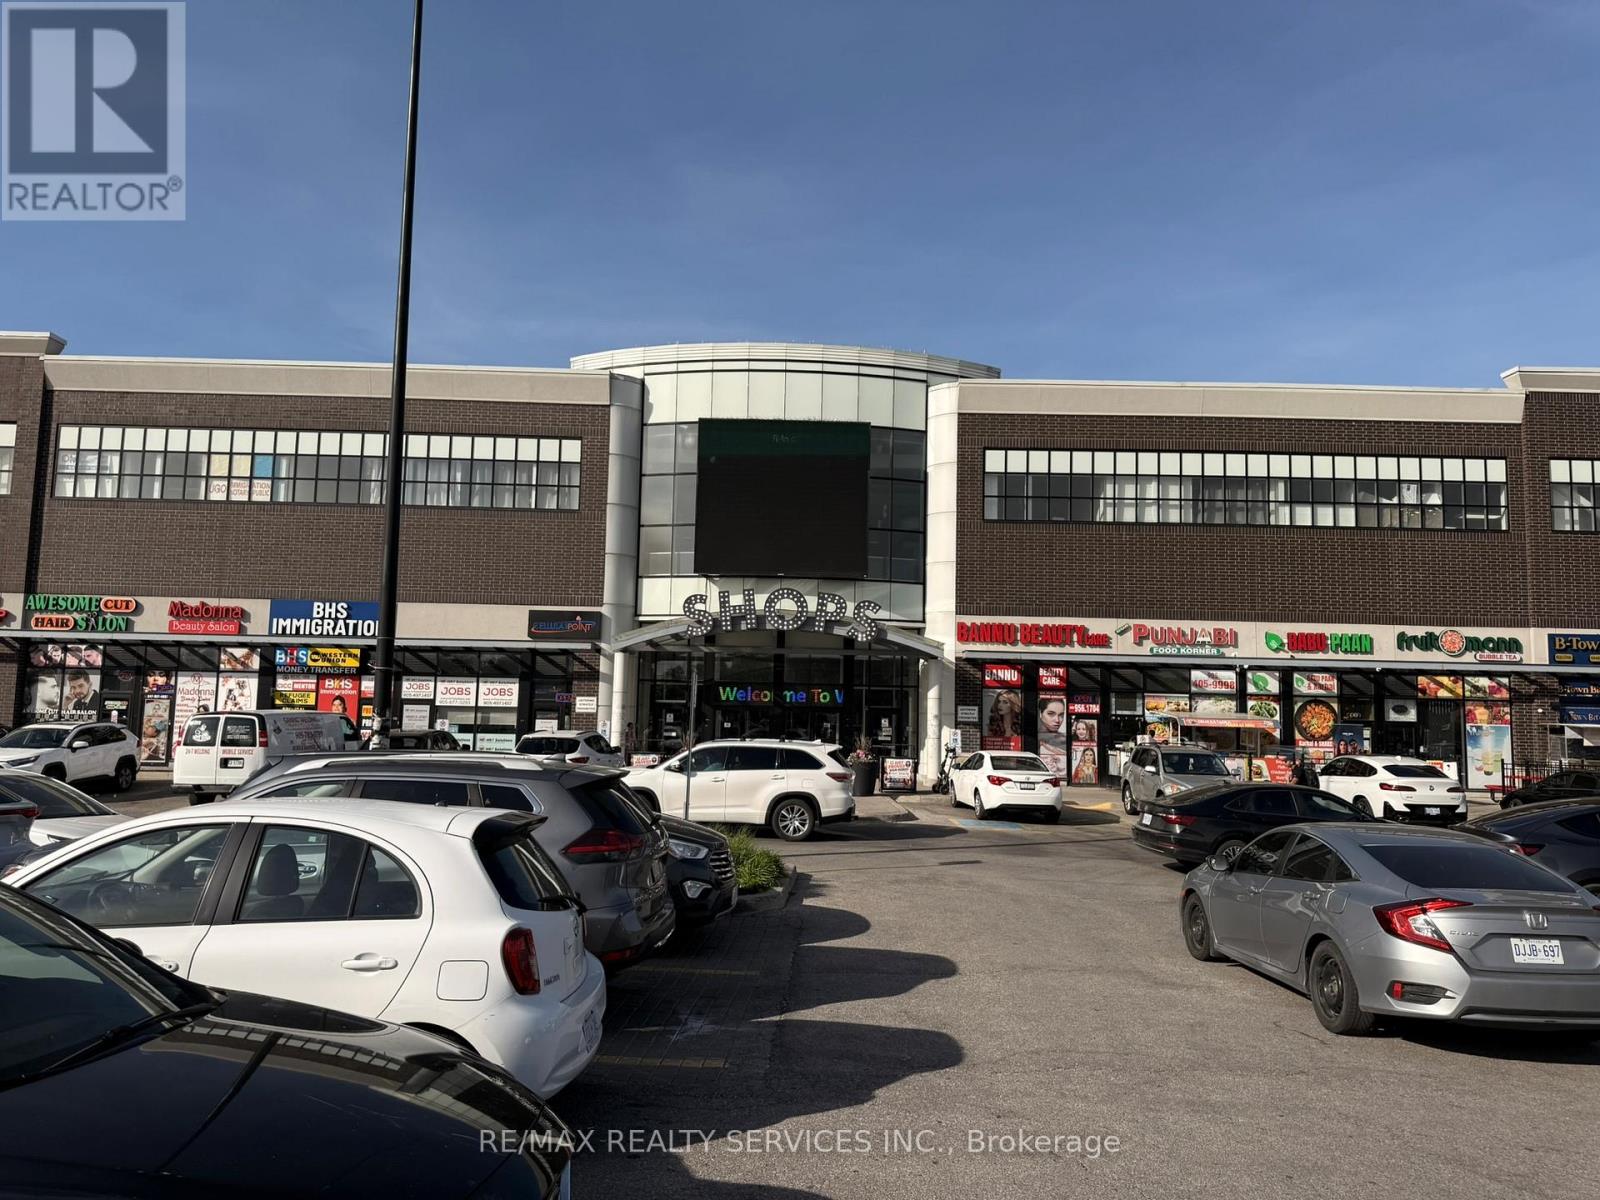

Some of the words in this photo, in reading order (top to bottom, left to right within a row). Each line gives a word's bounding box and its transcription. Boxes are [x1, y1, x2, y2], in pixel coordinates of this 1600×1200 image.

[25, 594, 101, 611] AWESOME
[104, 600, 132, 610] CUT
[168, 601, 243, 618] Madonna
[313, 602, 348, 619] BHS
[683, 588, 881, 641] SHOPS
[34, 617, 70, 628] HAIR
[173, 621, 205, 633] Beauty
[207, 621, 235, 632] Salon
[272, 618, 378, 636] IMMIGRATIO
[957, 621, 1015, 643] BANNU
[1019, 623, 1087, 645] BEAUTY
[1086, 633, 1109, 645] CARE
[1132, 624, 1235, 645] PUNJABI
[1287, 633, 1327, 651] BABU
[1330, 634, 1372, 652] PAAN
[275, 649, 308, 662] BHS
[984, 669, 1018, 681] BANNU
[1040, 667, 1064, 676] BEAUTY
[324, 678, 353, 689] BHS
[1042, 676, 1061, 685] CARE
[1192, 680, 1236, 690] 405-9998
[177, 687, 215, 696] Madonna
[405, 683, 431, 691] JOBS
[441, 686, 472, 696] JOBS
[482, 687, 514, 697] JOBS
[811, 689, 830, 703] To
